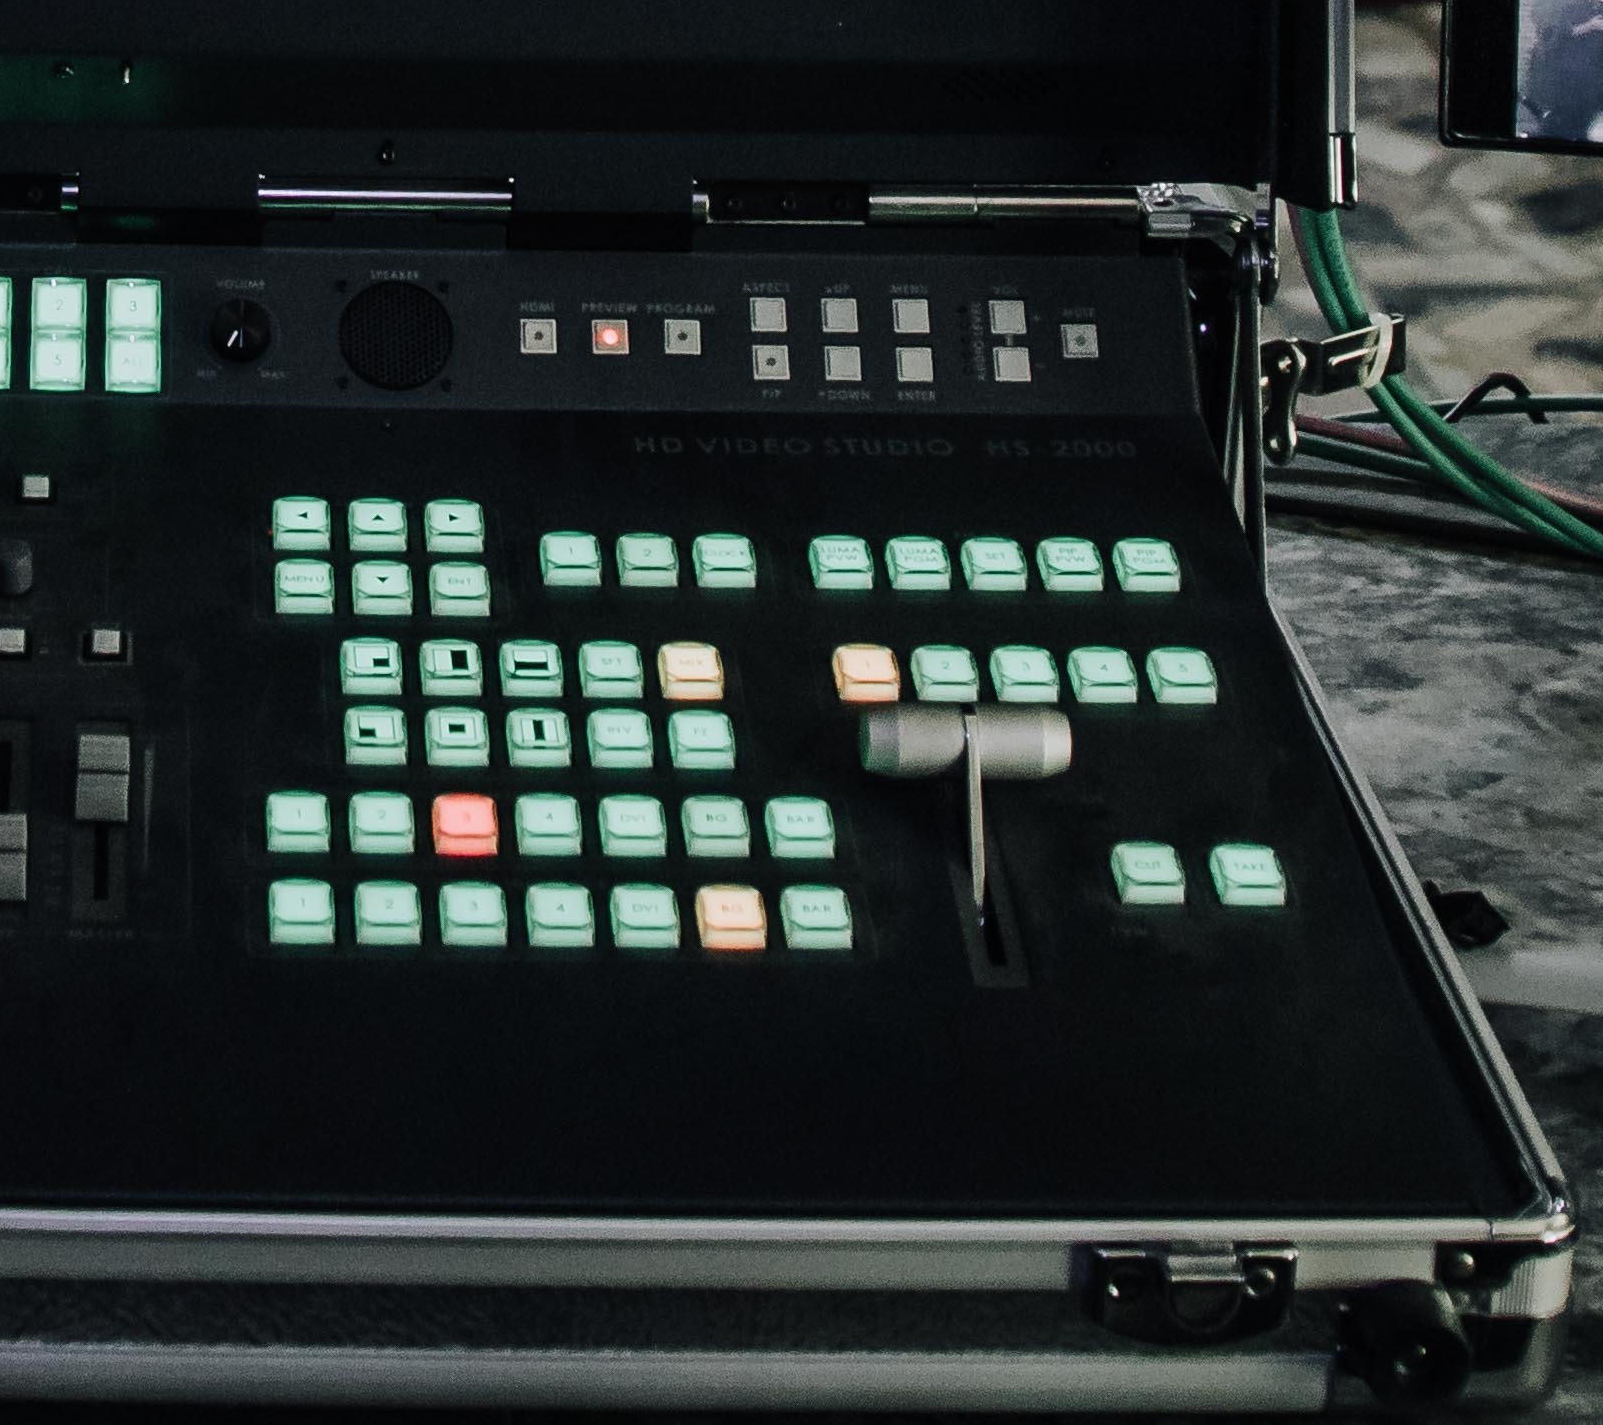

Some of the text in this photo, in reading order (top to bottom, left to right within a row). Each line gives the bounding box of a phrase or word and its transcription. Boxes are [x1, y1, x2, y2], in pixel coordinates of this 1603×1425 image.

[581, 302, 638, 314] PREVIEW
[697, 437, 812, 456] VIDEO
[823, 438, 955, 457] STUDIO
[284, 574, 325, 584] MENU
